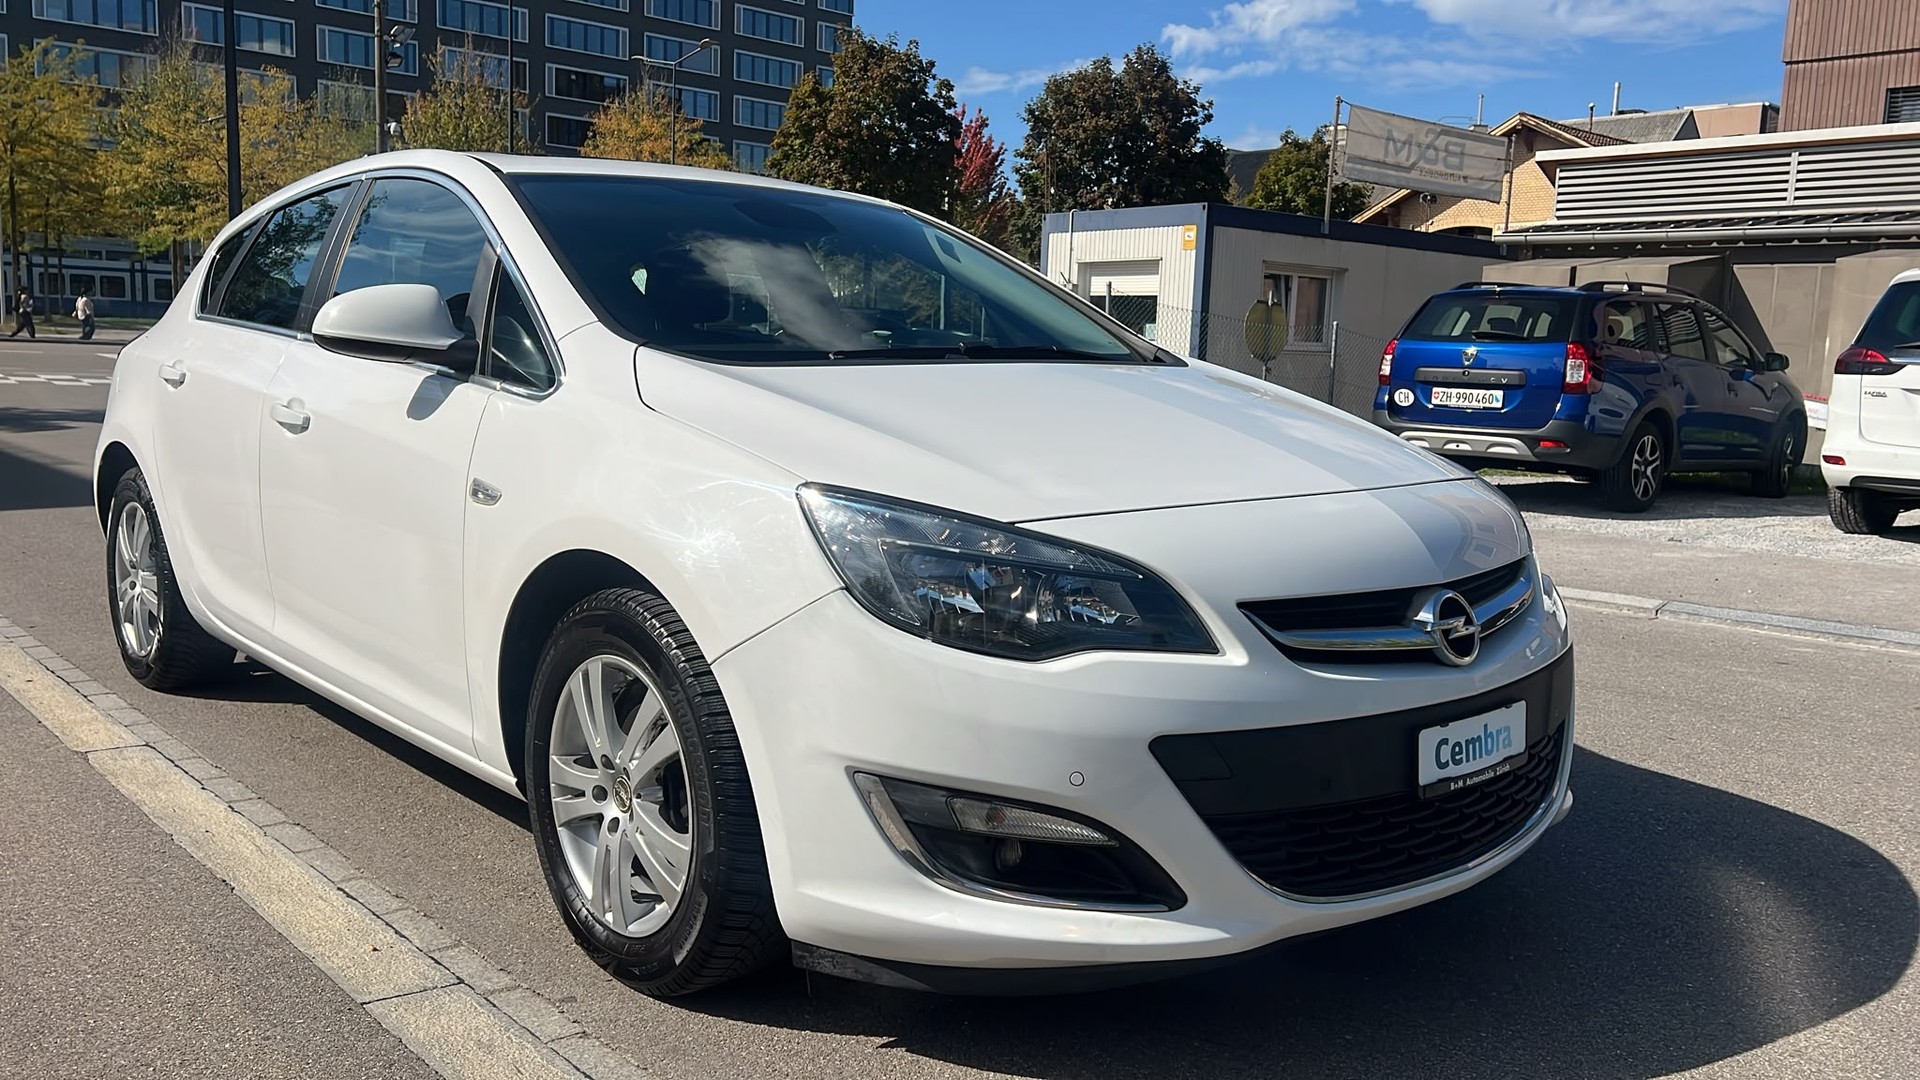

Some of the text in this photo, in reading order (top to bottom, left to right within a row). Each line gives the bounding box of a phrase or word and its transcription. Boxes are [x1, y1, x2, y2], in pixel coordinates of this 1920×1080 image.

[1398, 391, 1410, 404] CH
[1435, 724, 1512, 770] Cembra
[1466, 771, 1495, 786] Automobile
